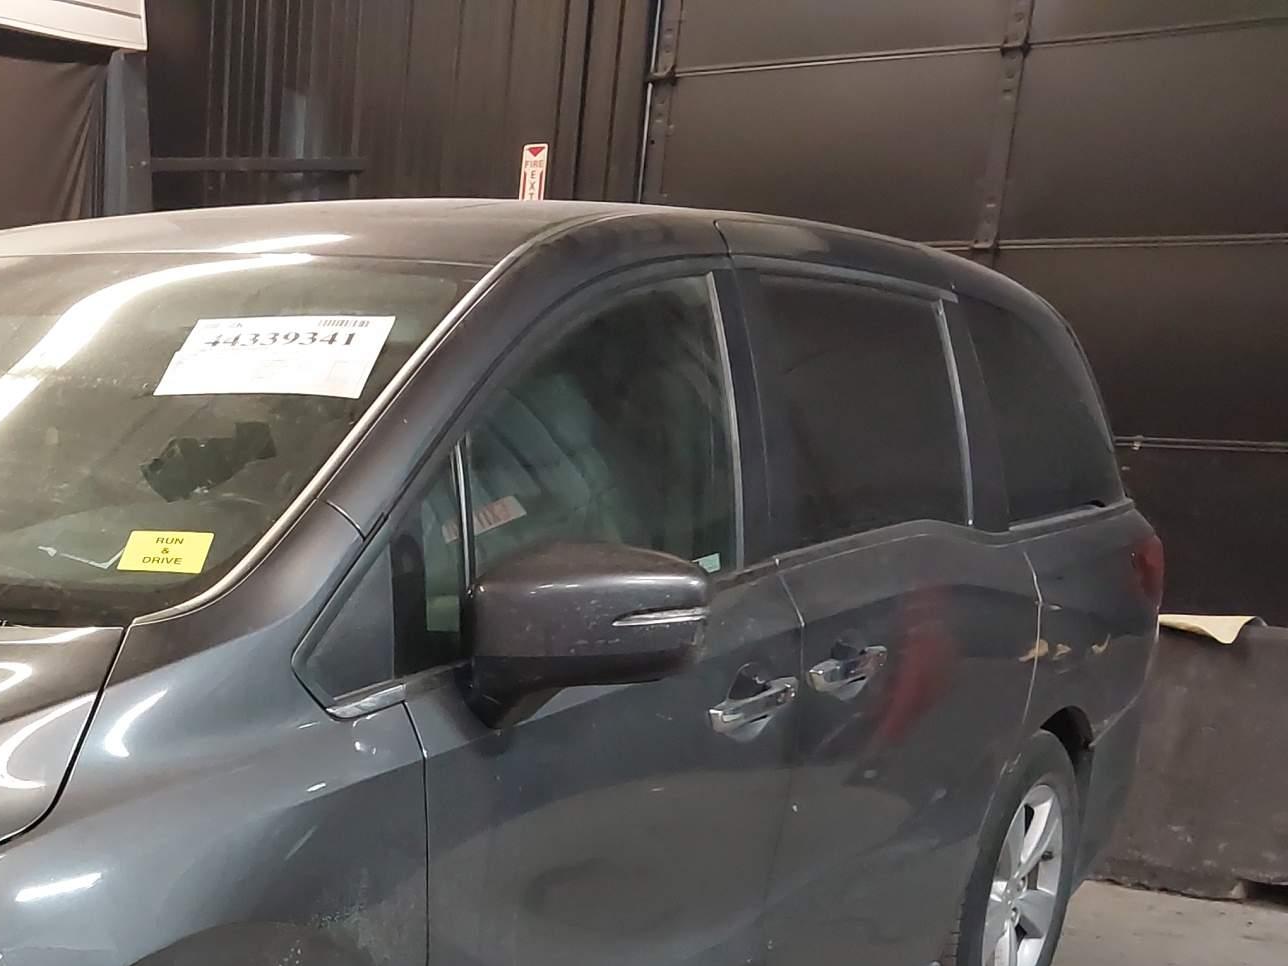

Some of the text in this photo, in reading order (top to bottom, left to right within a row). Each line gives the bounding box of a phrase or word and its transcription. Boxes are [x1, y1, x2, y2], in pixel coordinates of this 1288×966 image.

[524, 160, 544, 168] FIRE
[203, 331, 357, 347] 44339341
[155, 537, 184, 545] RUN
[142, 556, 183, 565] DRIVE
